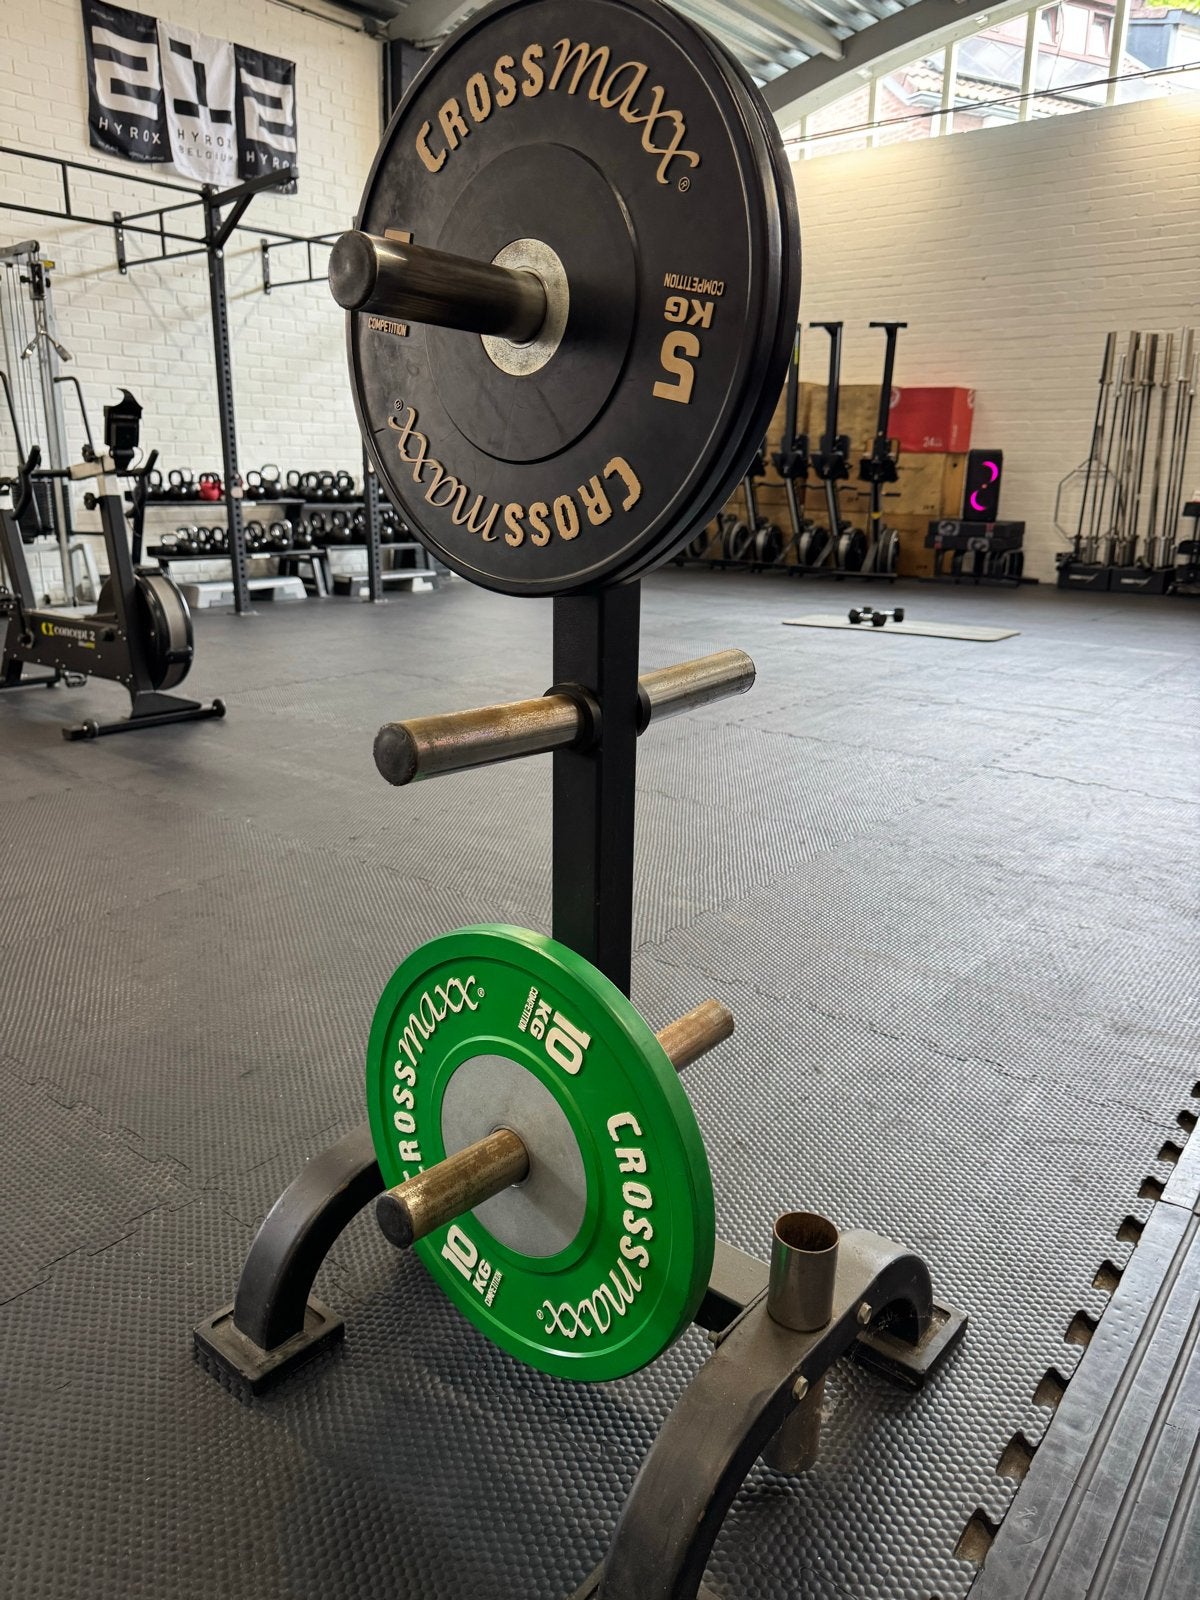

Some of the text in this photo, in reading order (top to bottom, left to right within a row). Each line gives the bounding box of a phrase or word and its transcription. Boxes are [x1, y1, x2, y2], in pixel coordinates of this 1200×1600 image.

[98, 116, 161, 144] HYROX
[246, 151, 297, 171] HYRO
[664, 273, 724, 296] COMPETITION
[368, 317, 408, 337] COMPETITION
[664, 296, 714, 328] KG
[653, 330, 700, 404] 5
[518, 986, 538, 1032] COMPETITION
[530, 999, 552, 1040] KG
[545, 1011, 591, 1075] 10
[441, 1225, 478, 1281] 10
[473, 1259, 491, 1295] KG
[485, 1269, 502, 1307] COMPETITION
